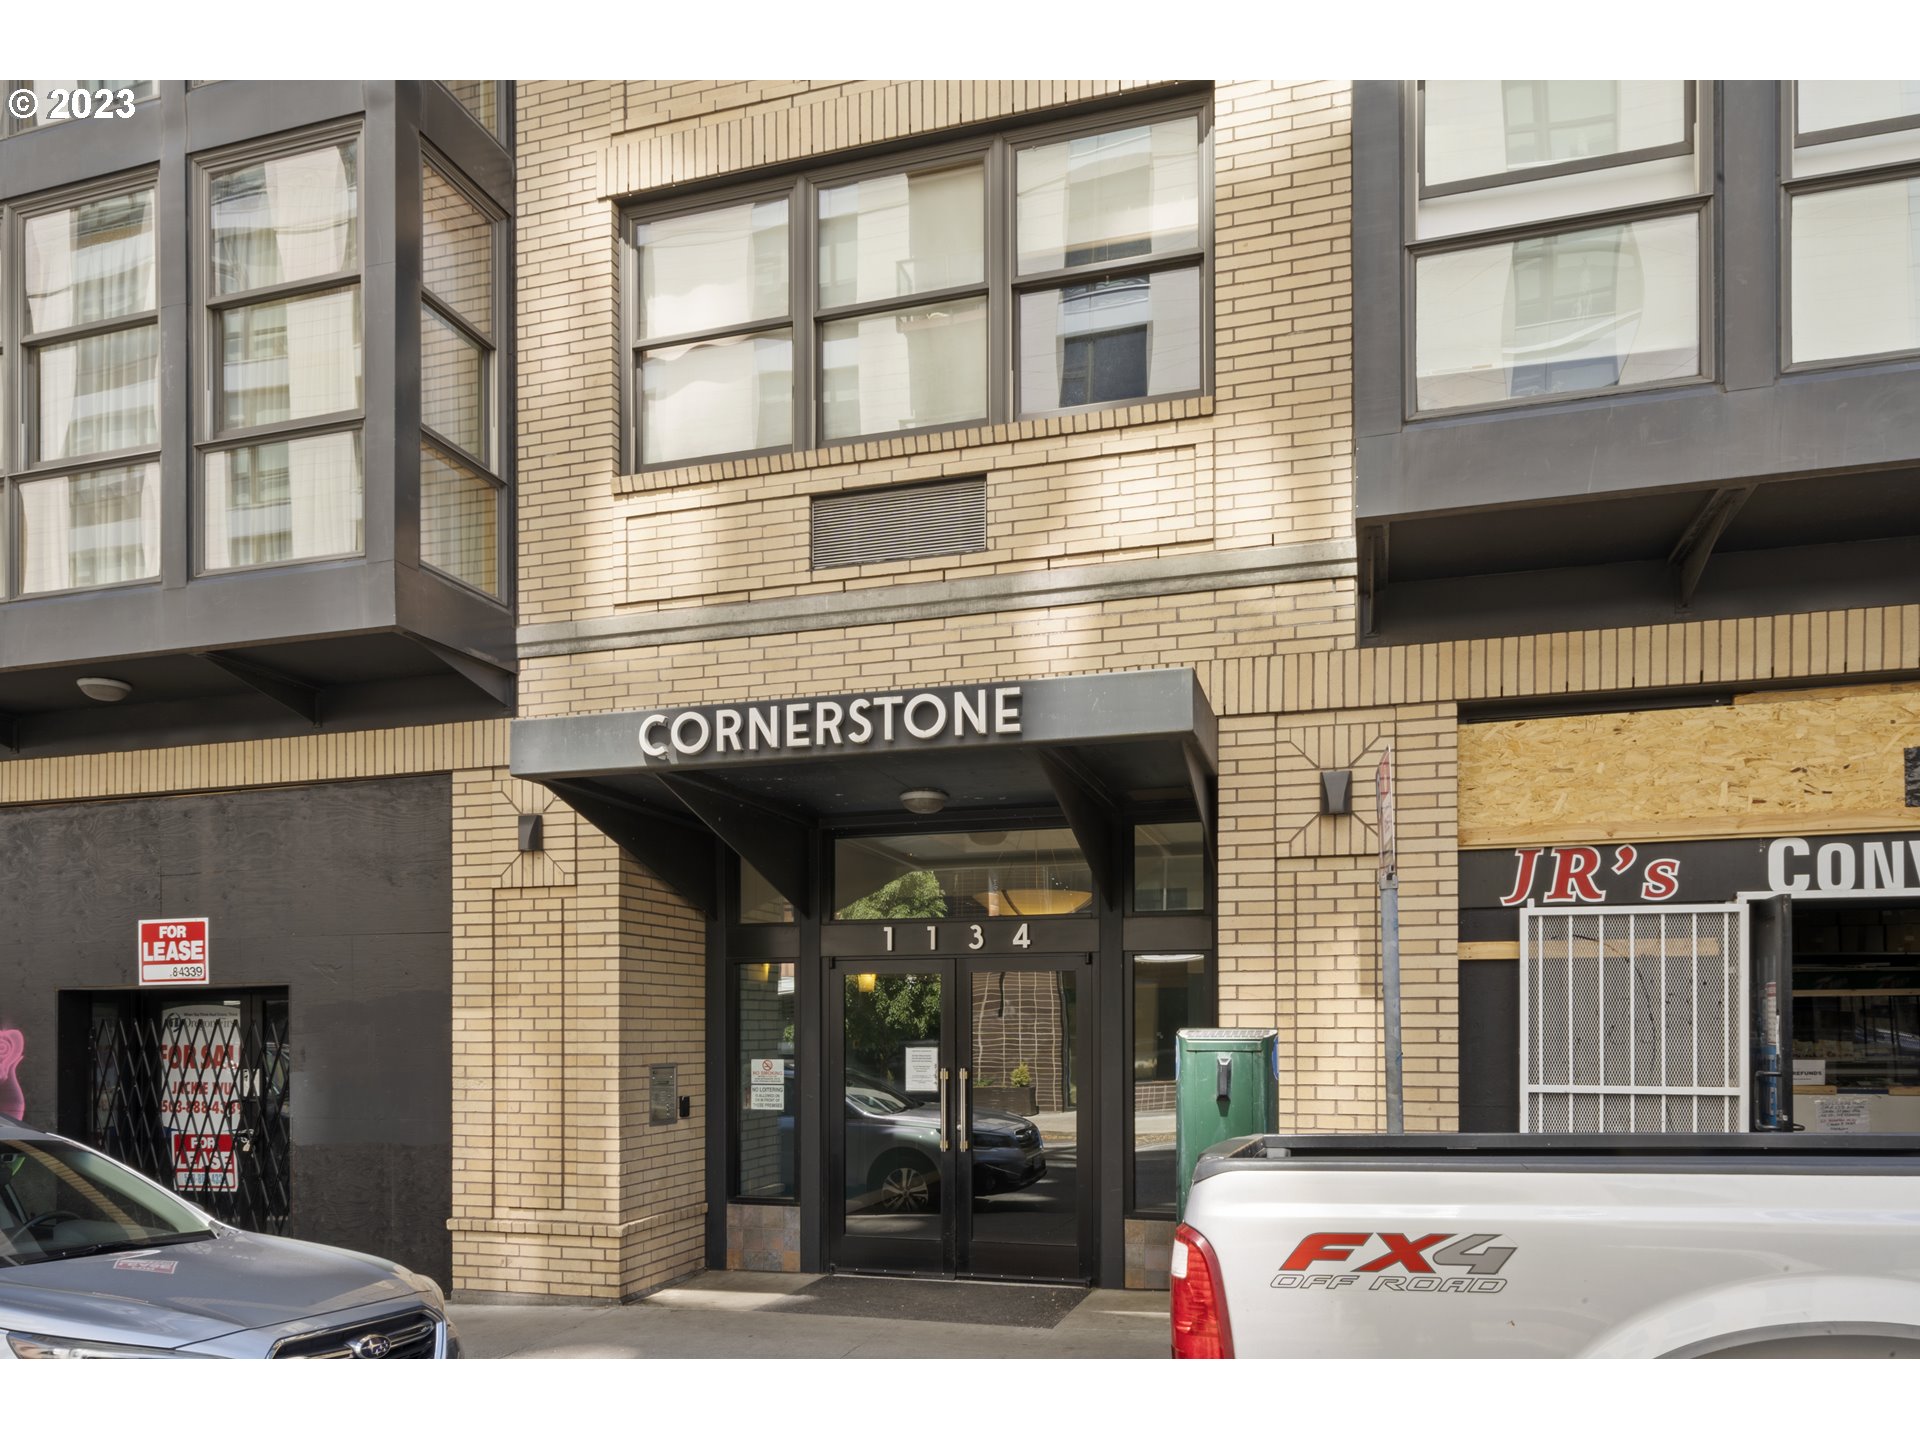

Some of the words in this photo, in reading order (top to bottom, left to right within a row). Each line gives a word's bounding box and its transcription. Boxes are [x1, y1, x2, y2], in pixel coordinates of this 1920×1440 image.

[638, 686, 1022, 758] CORNERSTONE
[1501, 844, 1681, 906] JR's
[159, 925, 186, 939] FOR
[143, 940, 204, 961] LEASE
[190, 1136, 216, 1149] FOR
[176, 1150, 233, 1170] LEASE
[1278, 1232, 1519, 1275] FX4
[1270, 1273, 1361, 1290] OFF
[1368, 1275, 1508, 1294] ROAD
